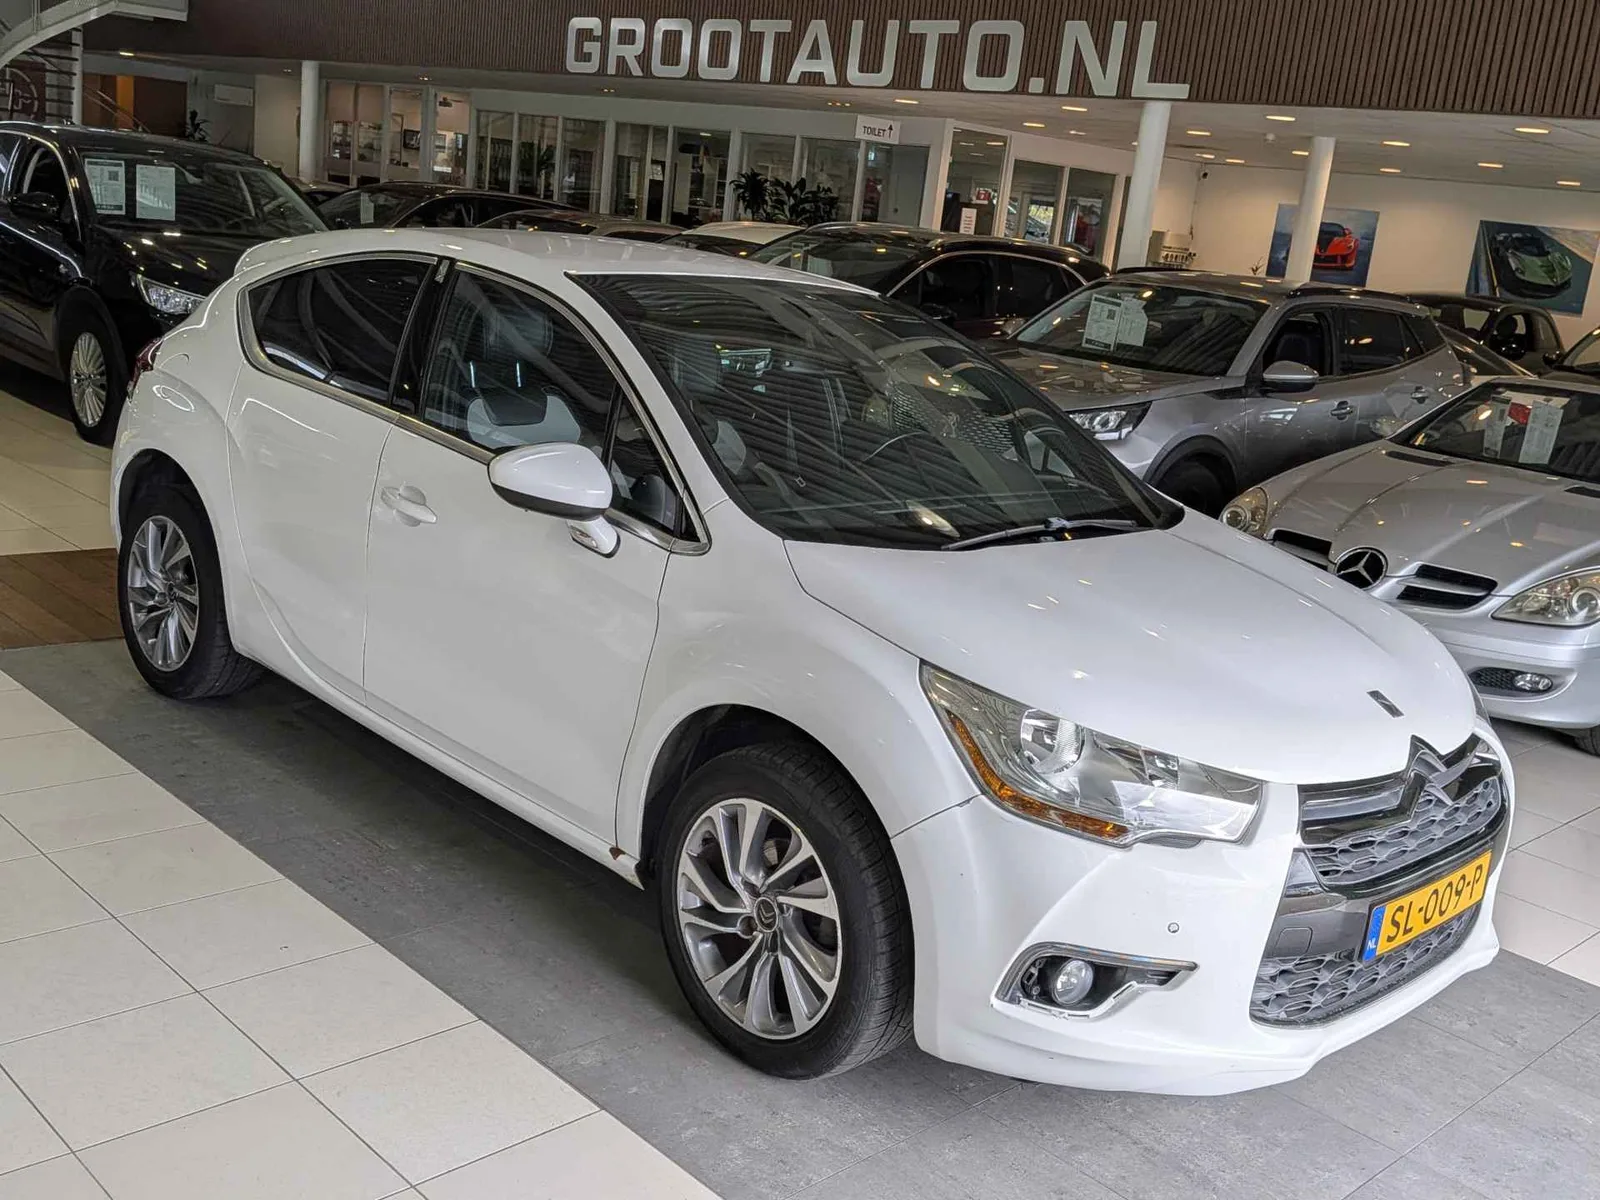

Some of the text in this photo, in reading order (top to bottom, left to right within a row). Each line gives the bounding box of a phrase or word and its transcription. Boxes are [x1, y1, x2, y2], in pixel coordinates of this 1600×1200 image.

[565, 16, 1190, 99] GROOTAUTO.NL
[862, 125, 886, 138] TOILET
[1386, 863, 1483, 943] SL-009-P
[1366, 937, 1377, 951] NL
